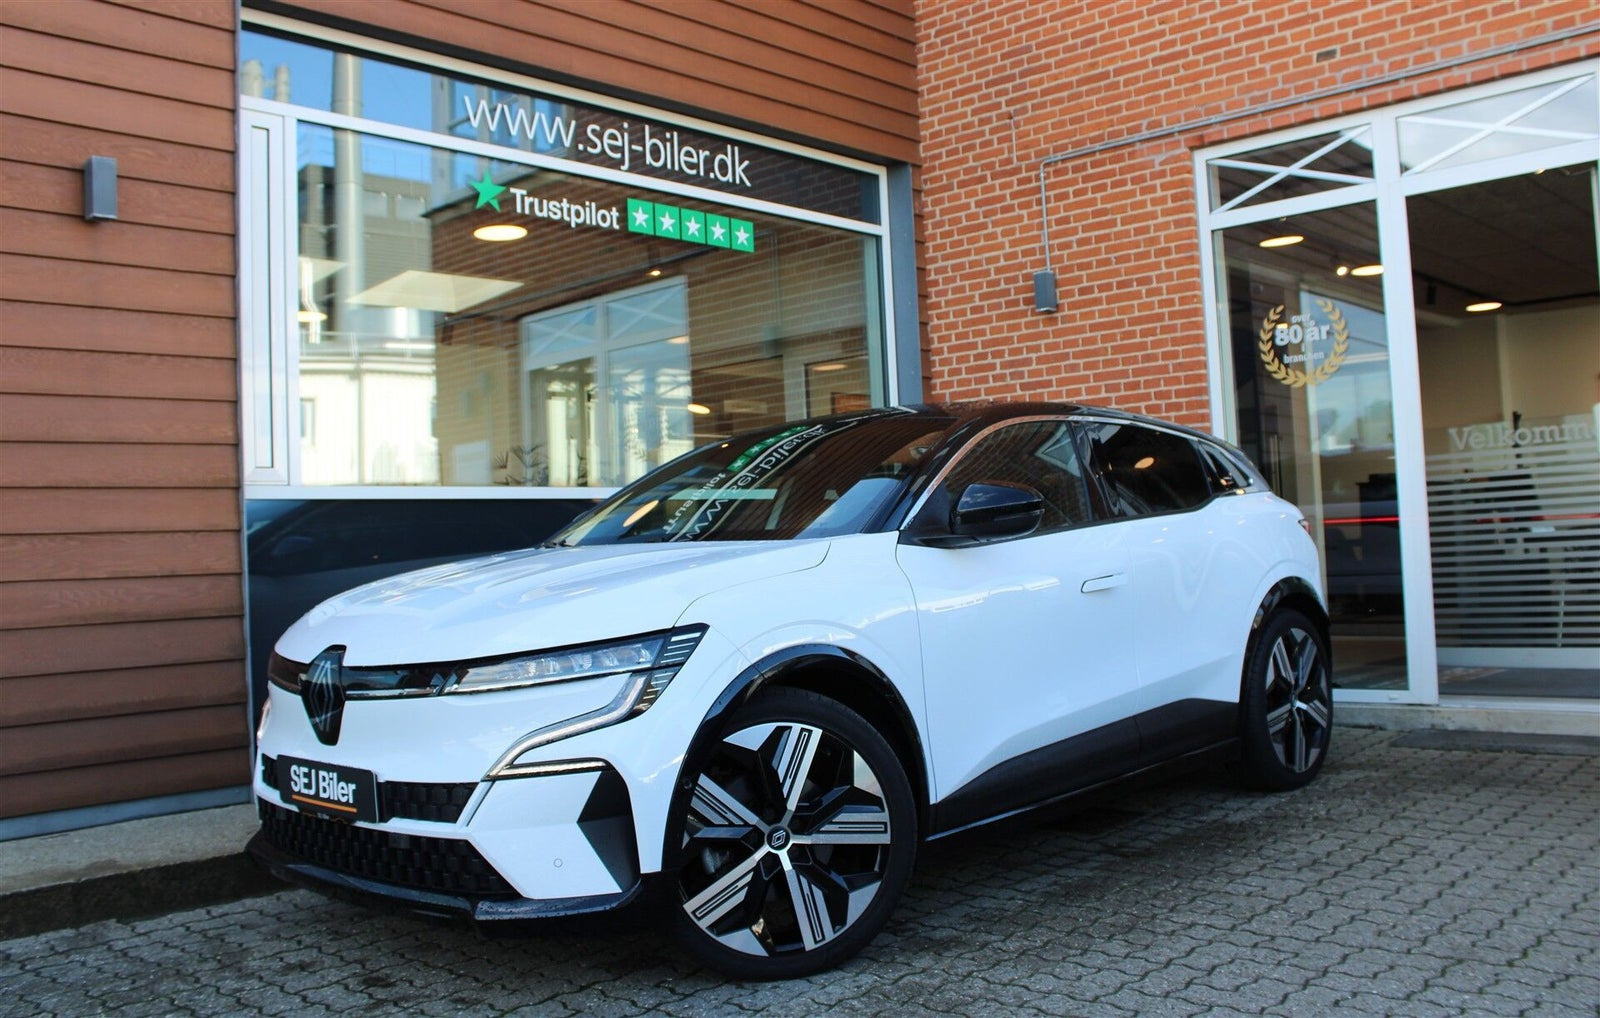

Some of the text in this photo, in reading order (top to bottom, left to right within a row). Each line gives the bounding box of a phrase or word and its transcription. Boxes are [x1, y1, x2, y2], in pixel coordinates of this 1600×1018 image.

[463, 95, 751, 187] www.sej-biler.dk
[509, 187, 620, 230] Trustpilot
[1274, 319, 1331, 347] 80 år
[1448, 423, 1593, 450] Velkomm
[290, 765, 356, 803] SEJ Biler
